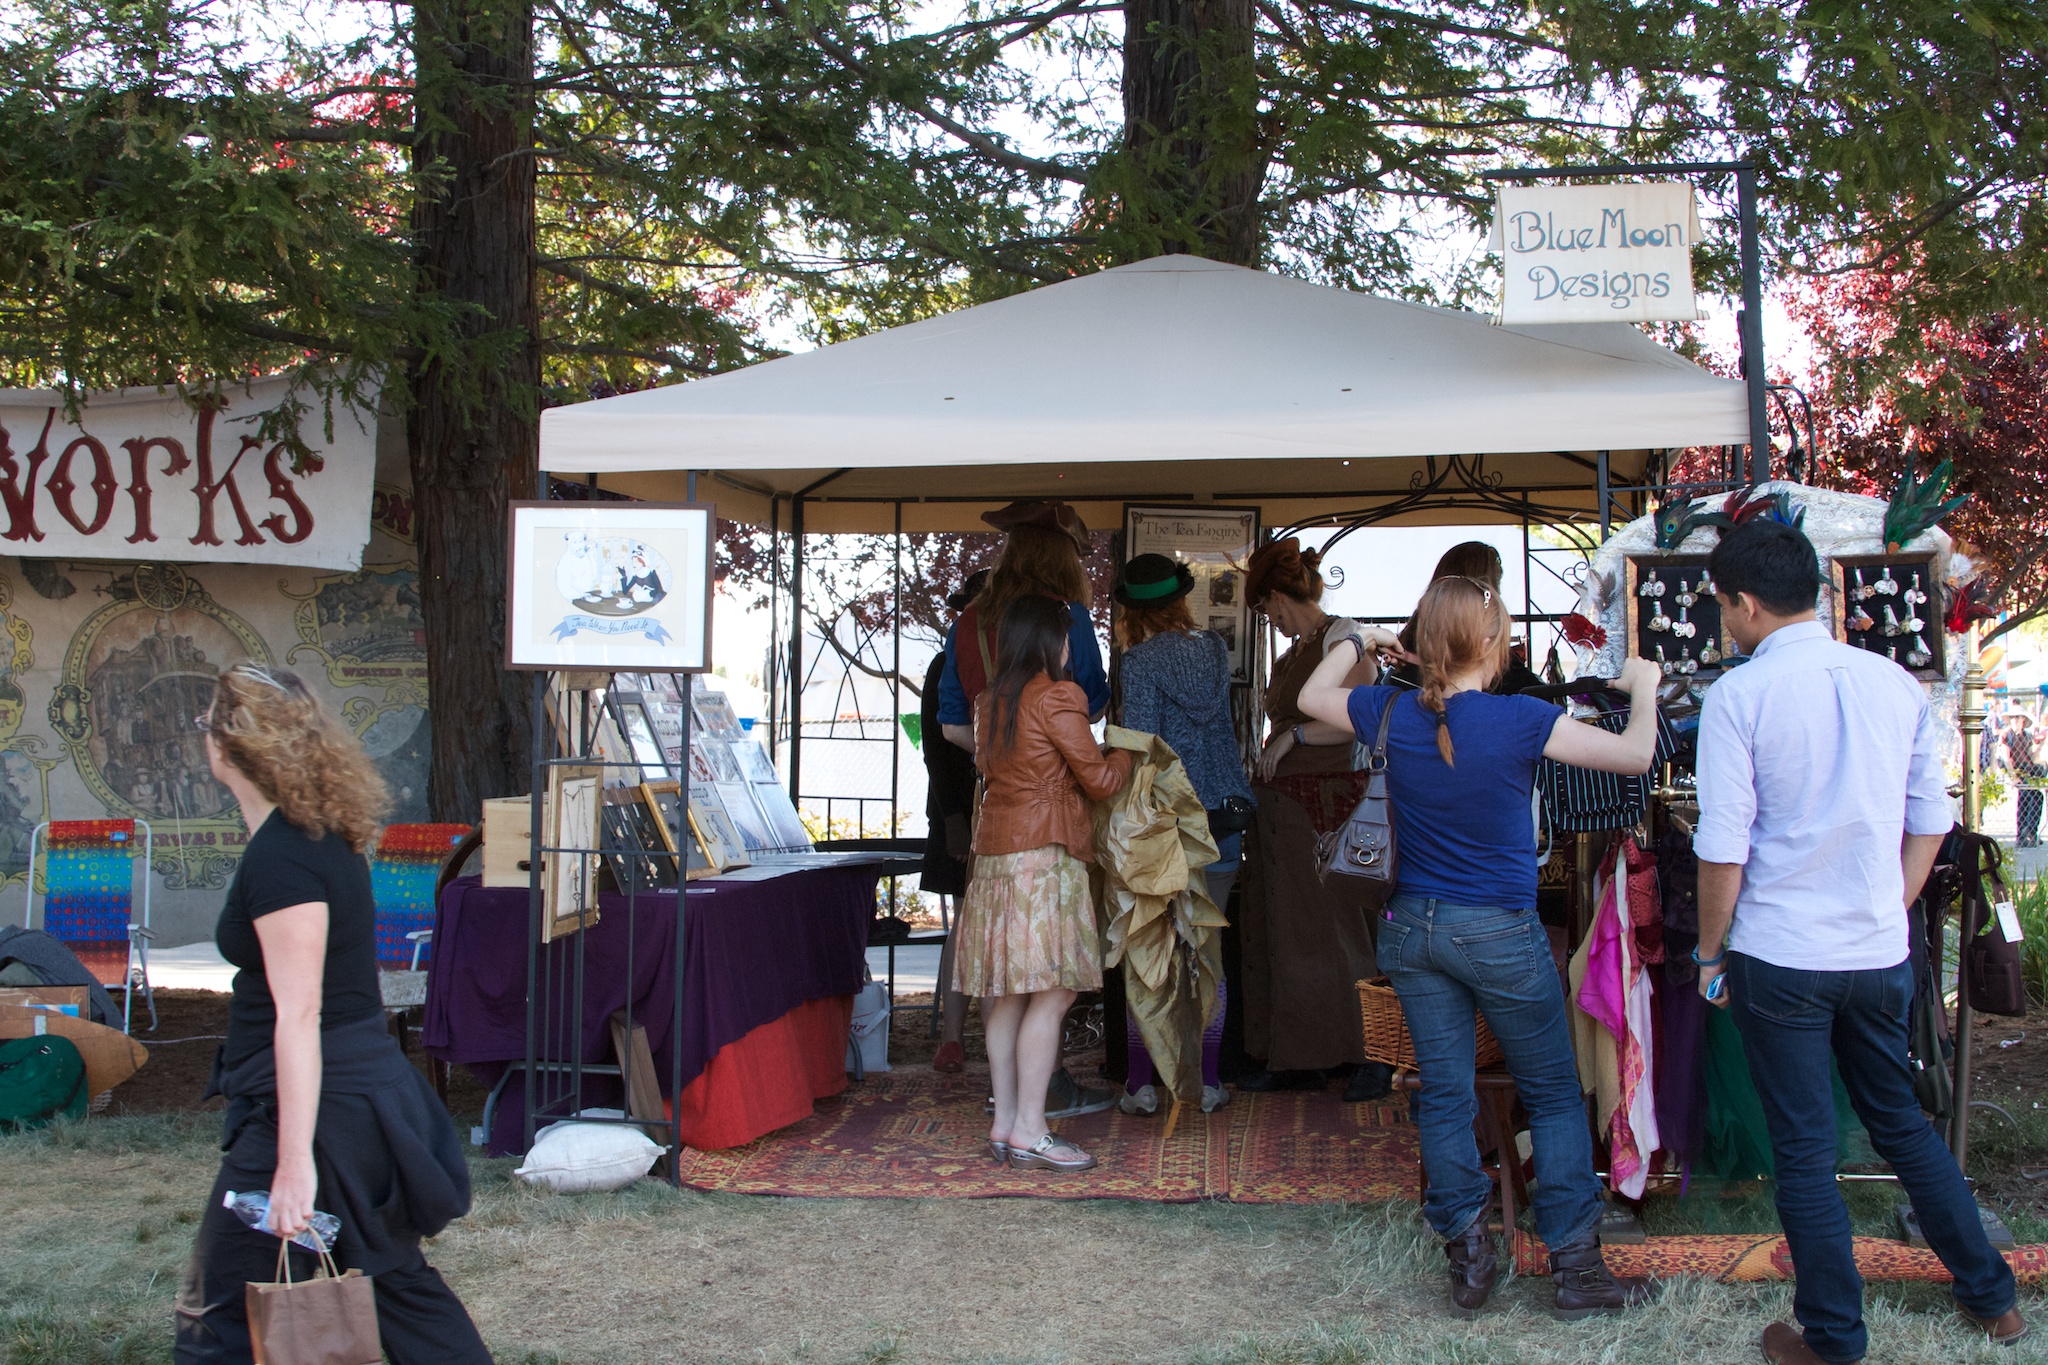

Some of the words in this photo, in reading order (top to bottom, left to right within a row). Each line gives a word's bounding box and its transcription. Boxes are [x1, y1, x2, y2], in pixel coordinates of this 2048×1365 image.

[1509, 210, 1594, 253] Blue
[1596, 208, 1686, 248] Moon
[1527, 265, 1671, 309] Designs
[1142, 521, 1169, 539] The
[1173, 521, 1195, 537] Tea
[1196, 523, 1242, 541] Engine
[134, 831, 217, 847] VERWAS
[221, 831, 251, 846] HA
